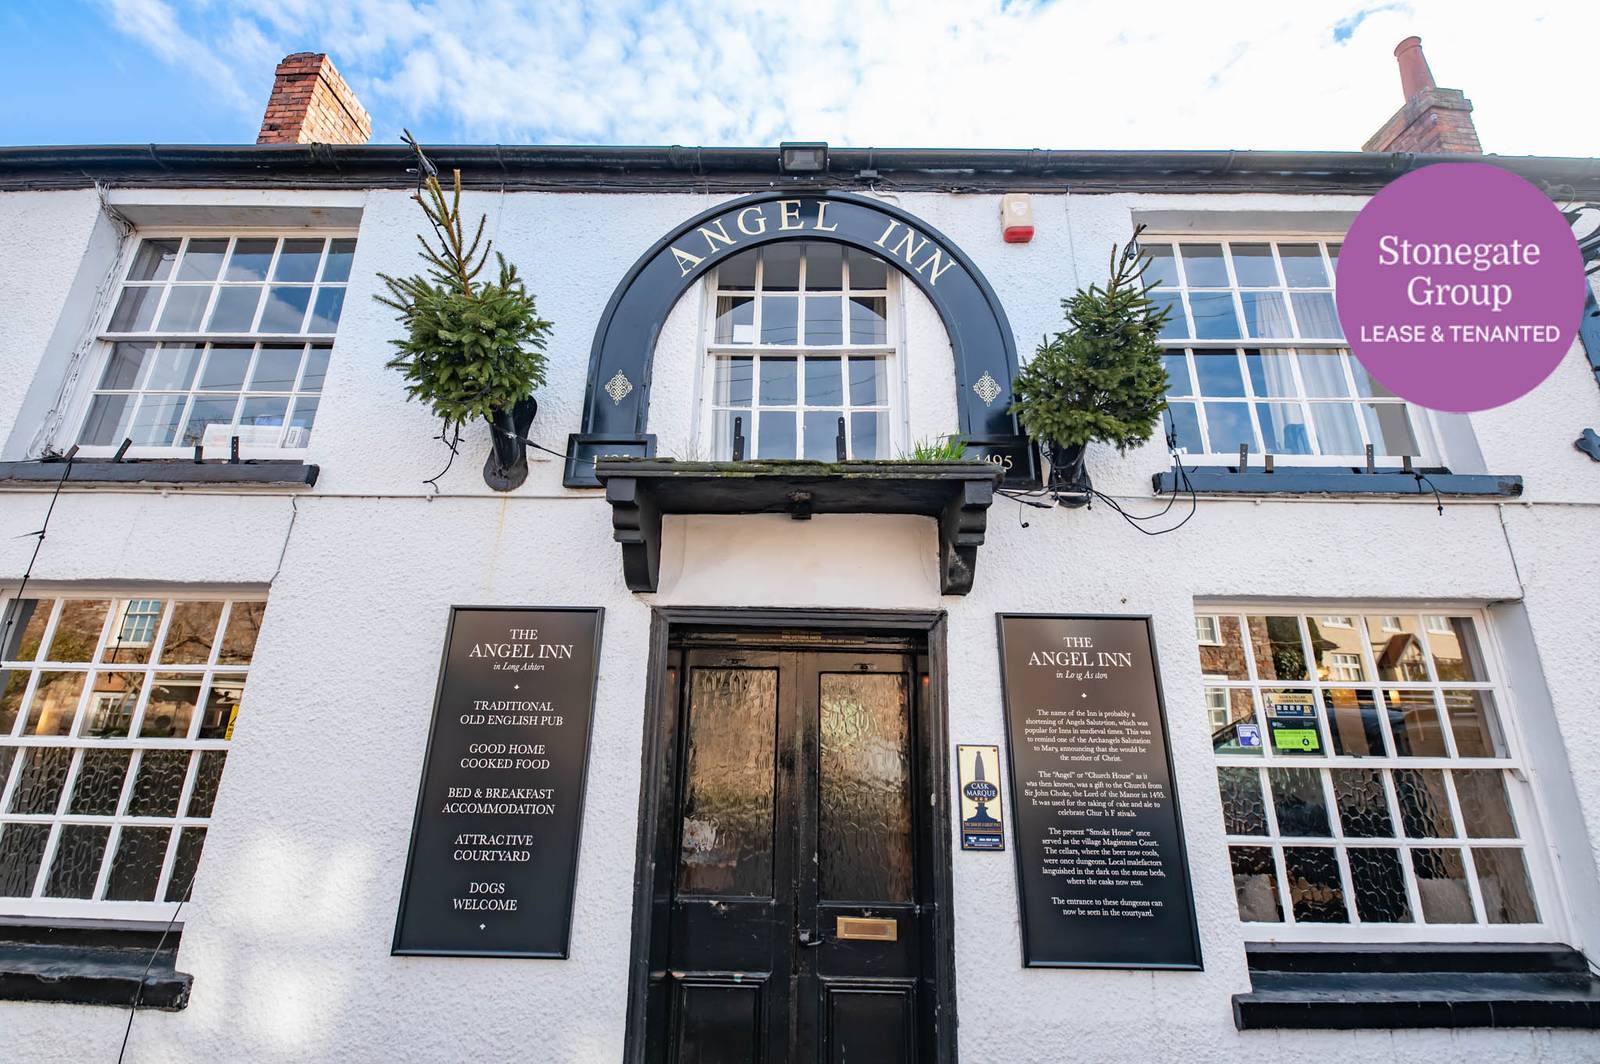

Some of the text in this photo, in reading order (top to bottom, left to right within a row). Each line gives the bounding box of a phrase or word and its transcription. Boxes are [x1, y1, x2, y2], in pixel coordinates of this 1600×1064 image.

[669, 200, 957, 286] ANGEL INN
[509, 628, 538, 640] THE
[1063, 636, 1093, 648] THE
[469, 643, 574, 659] ANGEL INN
[1028, 651, 1132, 668] ANGEL INN
[493, 662, 500, 670] in
[502, 662, 519, 672] Long
[1056, 670, 1063, 679] in
[474, 700, 554, 712] TRADITIONAL
[460, 714, 564, 726] OLD ENGLISH PUB
[1103, 710, 1129, 719] probably
[1025, 717, 1056, 726] shortening
[1024, 727, 1047, 735] popular
[1034, 735, 1055, 743] remind
[469, 743, 546, 755] GOOD HOME
[460, 758, 550, 770] COOKED FOOD
[1094, 781, 1104, 790] gift
[448, 787, 555, 800] BED & BREAKFAST
[967, 789, 996, 797] MARQUE
[1033, 789, 1048, 798] John
[1108, 790, 1118, 798] the
[442, 803, 556, 815] ACCOMMODATION
[1087, 799, 1106, 808] taking
[1062, 829, 1084, 837] present
[454, 834, 534, 846] ATTRACTIVE
[1081, 838, 1101, 847] village
[1102, 838, 1137, 847] Magistrates
[453, 849, 531, 862] COURTYARD
[1126, 858, 1162, 866] malefactors
[1042, 867, 1075, 876] languished
[469, 882, 506, 894] DOGS
[453, 898, 518, 911] WELCOME
[1102, 898, 1118, 906] these
[1119, 899, 1150, 908] dungeons
